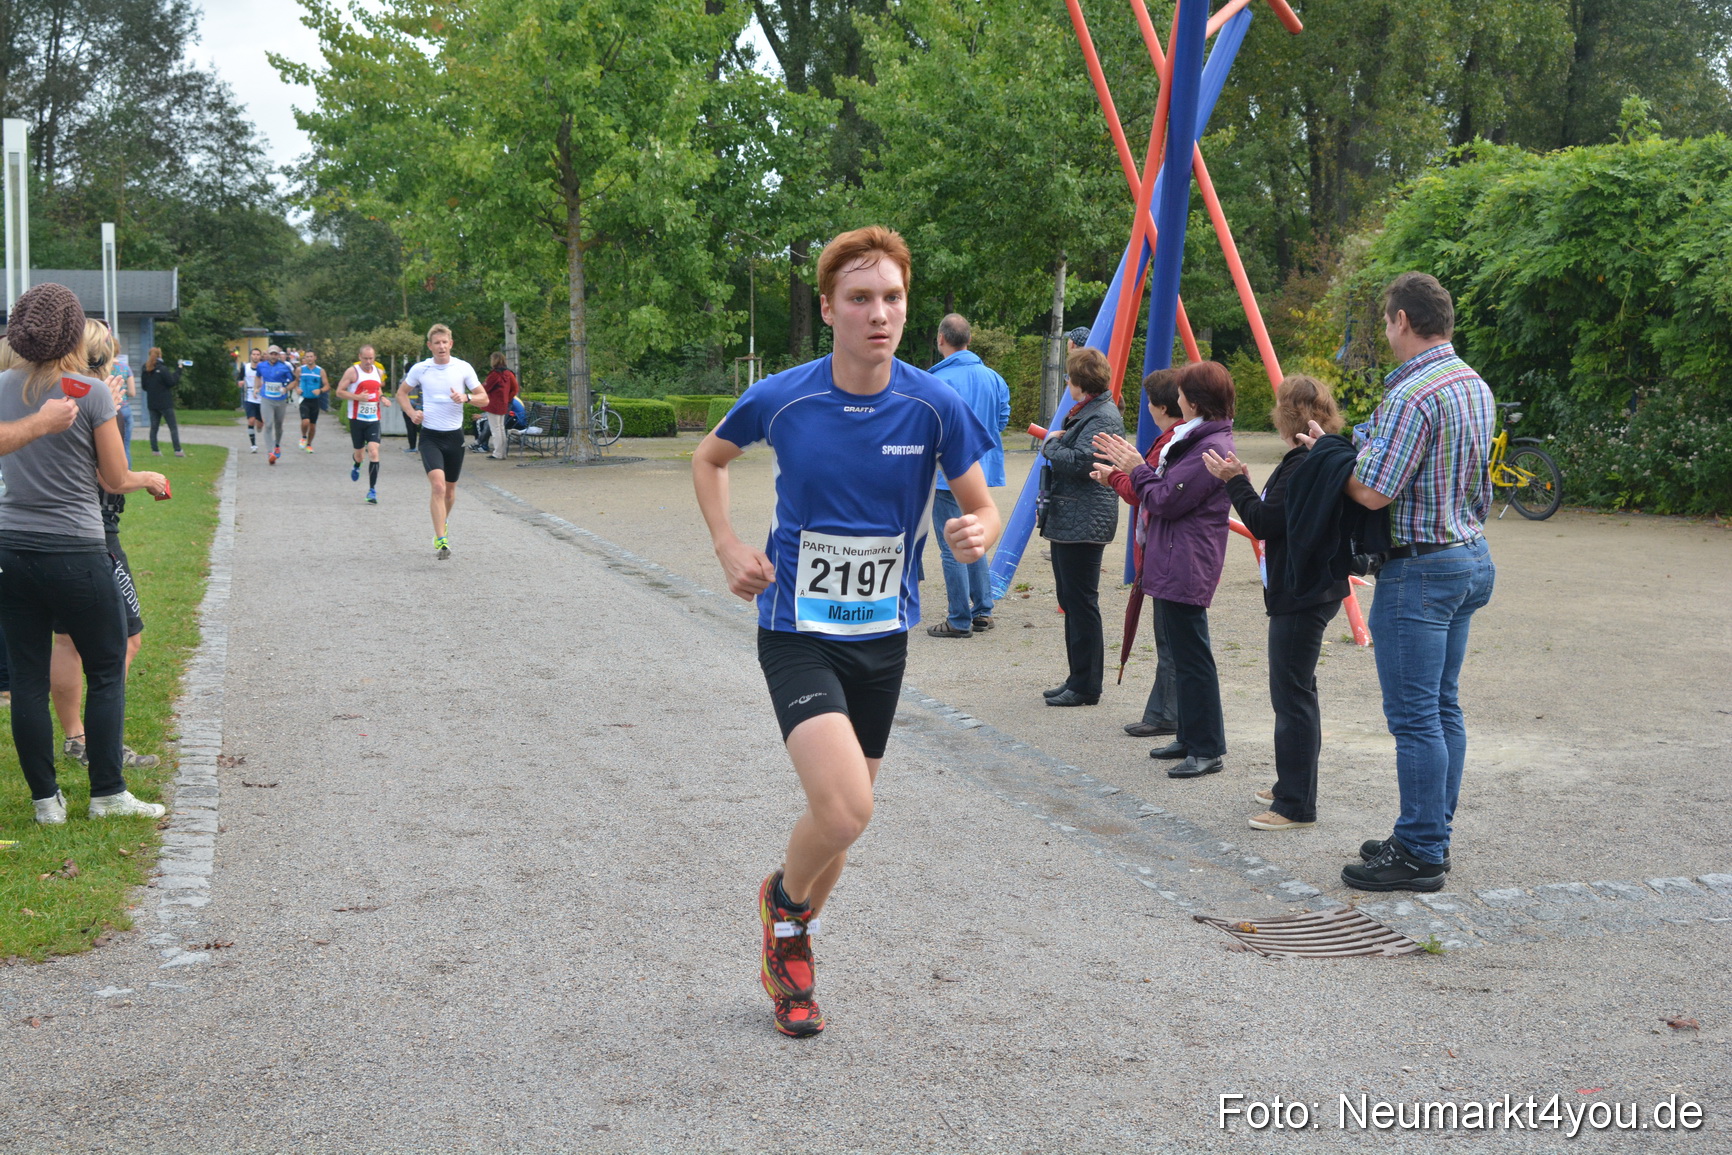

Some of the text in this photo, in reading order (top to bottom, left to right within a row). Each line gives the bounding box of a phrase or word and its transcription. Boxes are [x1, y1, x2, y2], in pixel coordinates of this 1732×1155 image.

[802, 540, 892, 556] PARTL Neumarkt
[808, 557, 897, 597] 2197
[828, 605, 874, 621] Martin
